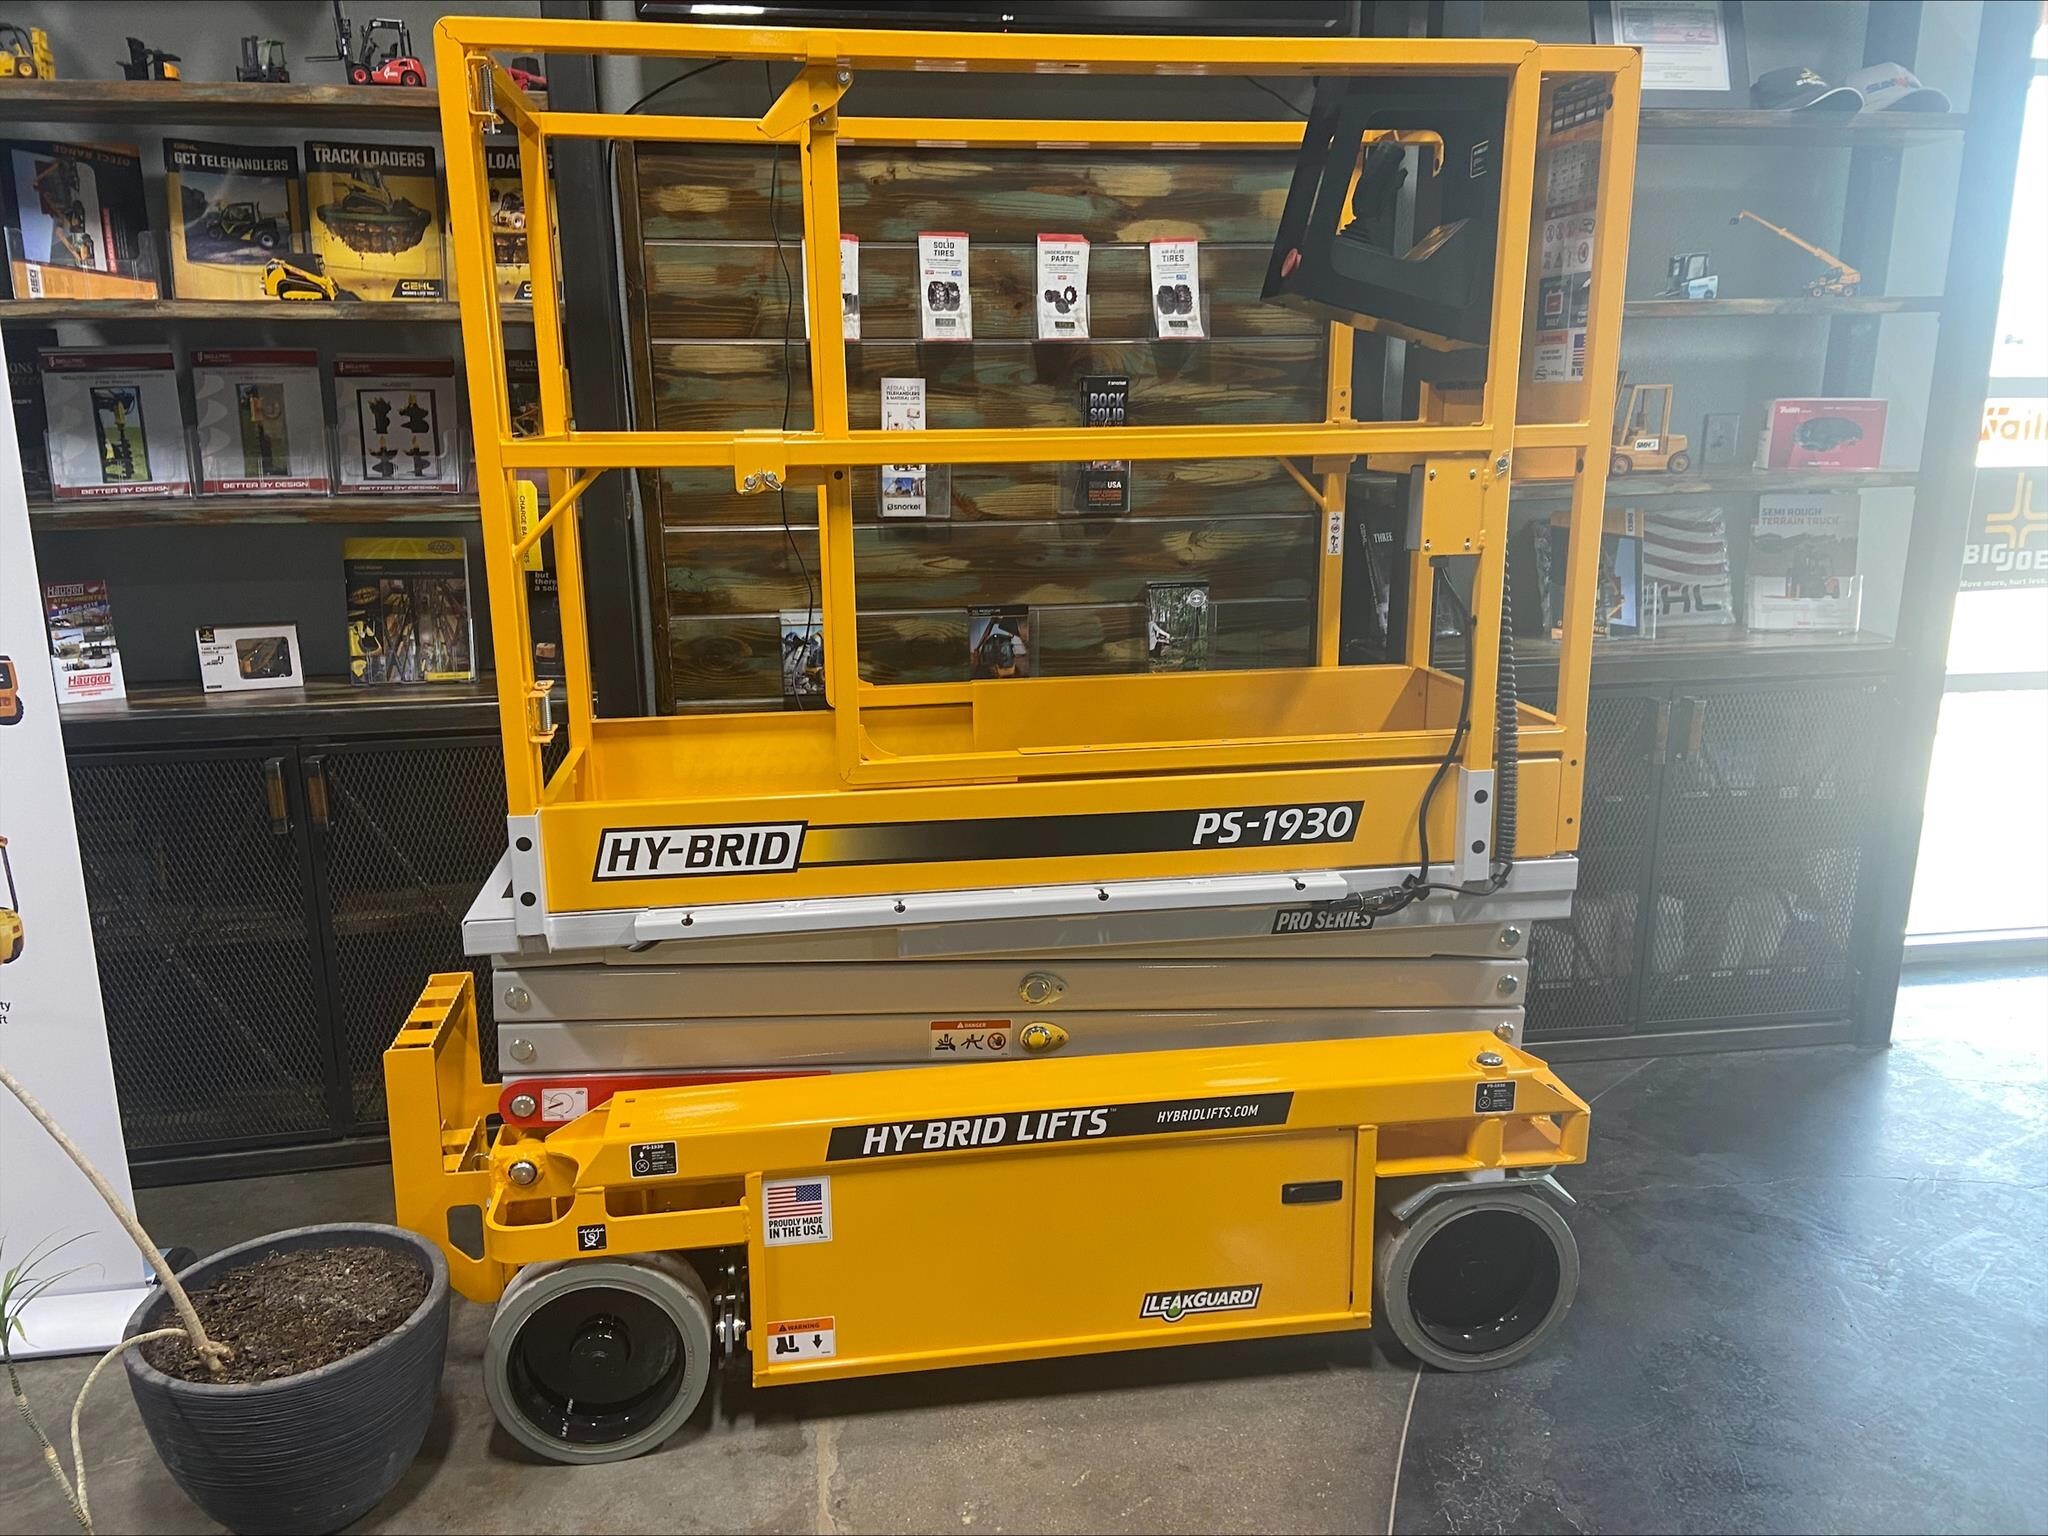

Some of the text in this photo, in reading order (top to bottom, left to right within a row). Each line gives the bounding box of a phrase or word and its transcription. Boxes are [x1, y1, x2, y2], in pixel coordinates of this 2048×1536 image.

[174, 151, 289, 171] GCT TELEHANDLERS
[312, 147, 425, 167] TRACK LOADERS
[488, 153, 554, 169] LOAS
[933, 241, 955, 249] SOLID
[933, 249, 955, 257] TIRES
[1050, 255, 1074, 263] PARTS
[1161, 254, 1185, 262] TIRES
[401, 281, 434, 290] GEHL
[1090, 392, 1125, 407] ROCK
[1090, 407, 1125, 421] SOLID
[81, 487, 118, 495] BETTER
[135, 485, 170, 493] DESIGN
[223, 481, 259, 489] BETTER
[1107, 481, 1122, 489] USA
[519, 495, 528, 524] CHARGE
[1761, 507, 1823, 516] SEMI ROUGH
[1761, 516, 1840, 526] TERRAIN TRUCK
[1374, 531, 1393, 543] THREE
[1962, 543, 2048, 571] BIG JOE
[534, 571, 549, 579] but
[47, 584, 84, 597] Haugen
[68, 672, 111, 688] Haugen
[606, 805, 1354, 873] HY-BRID PS-1930
[1276, 909, 1372, 931] PRO SERIES
[863, 1103, 1260, 1156] HY-BRID LIFTS HYBRIDLIFTS.COM
[768, 1215, 823, 1228] PROUDLY MADE
[769, 1224, 824, 1239] IN THE USA
[1148, 1288, 1254, 1312] LEAKGUARD
[787, 1322, 820, 1331] WARNING
